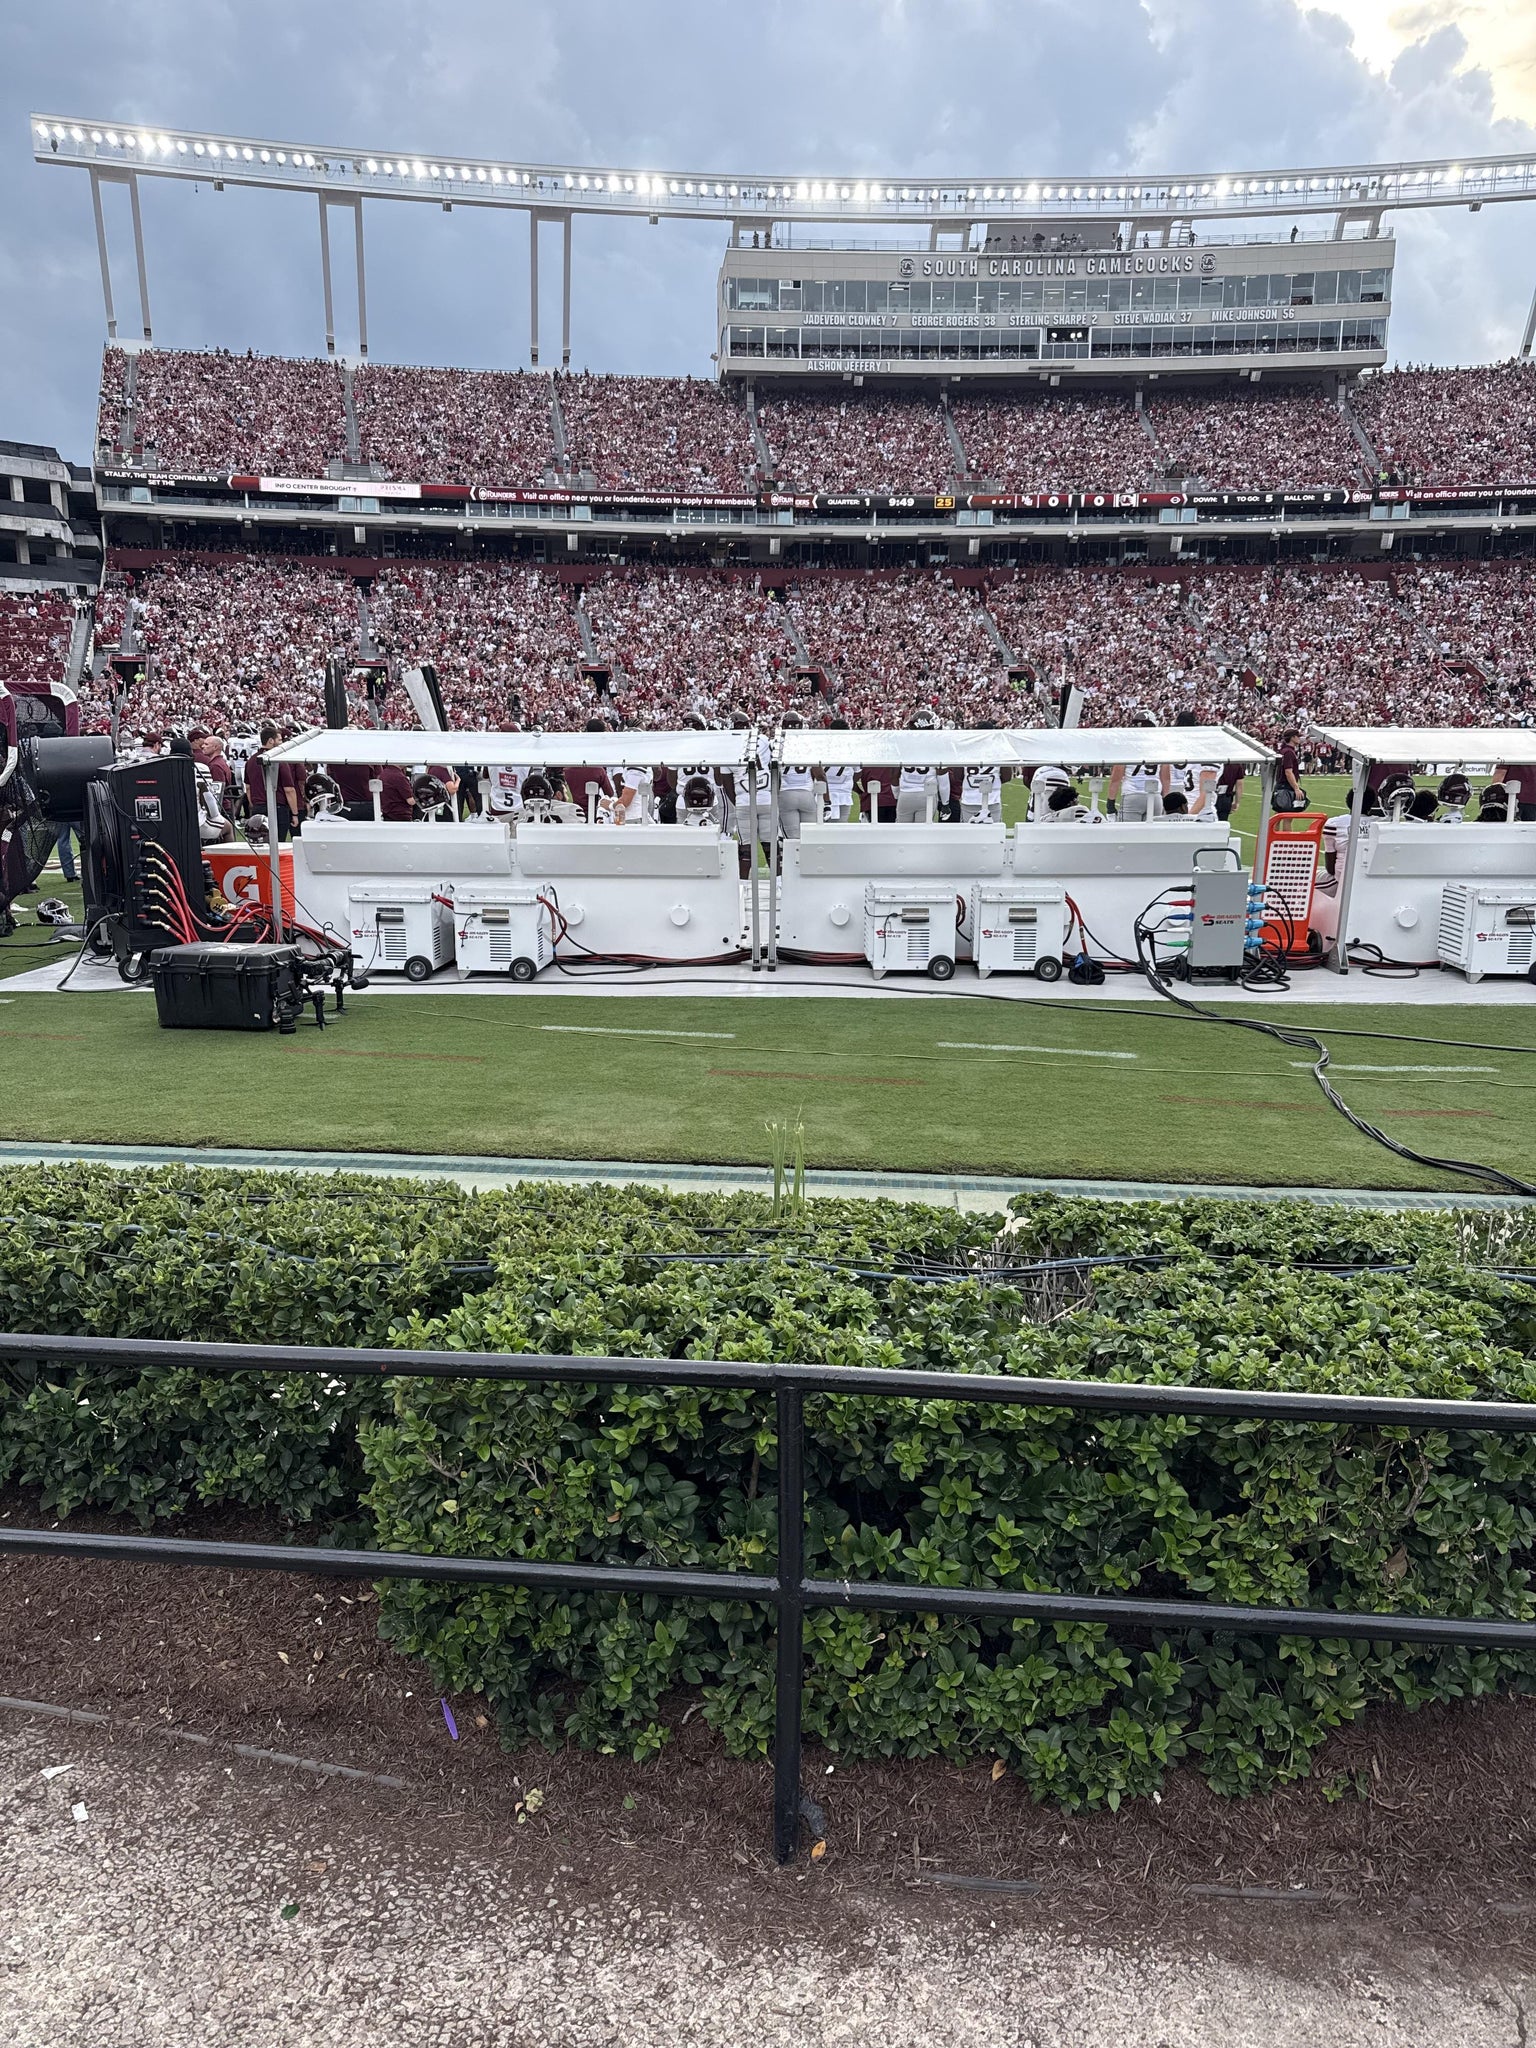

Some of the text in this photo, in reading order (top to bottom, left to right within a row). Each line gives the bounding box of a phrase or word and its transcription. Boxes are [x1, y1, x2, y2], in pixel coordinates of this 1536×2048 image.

[923, 259, 978, 276] SOUTH
[989, 258, 1076, 276] CAROLINA
[1086, 255, 1194, 274] GAMECOCKS
[803, 314, 898, 327] JADEVEON CLOWNEY 7
[911, 315, 996, 327] GEORGE ROGERS 38
[1009, 314, 1098, 327] STERLING SHARPE 2
[1114, 312, 1193, 325] STEVE WADIAK 37
[1211, 308, 1295, 322] MIKE JOHNSON 56
[807, 360, 891, 372] ALSHON JEFFERY 1
[104, 470, 133, 479] STALEY,
[168, 474, 207, 482] CONTINUES
[208, 475, 218, 483] TO
[522, 492, 537, 500] Visit
[549, 492, 570, 501] office
[571, 494, 588, 502] near
[589, 495, 603, 503] you
[673, 496, 681, 504] to
[682, 497, 702, 506] apply
[703, 496, 713, 505] for
[1222, 495, 1229, 503] 1
[1265, 494, 1273, 503] 5
[1322, 493, 1332, 501] 5
[1435, 490, 1457, 498] office
[1478, 490, 1493, 499] you
[827, 497, 871, 507] QUARTER: 1
[888, 498, 915, 507] 9:49
[936, 498, 952, 507] 25
[1047, 496, 1059, 508] 0
[1093, 495, 1105, 507] 0
[503, 792, 514, 807] 5
[222, 865, 260, 908] G
